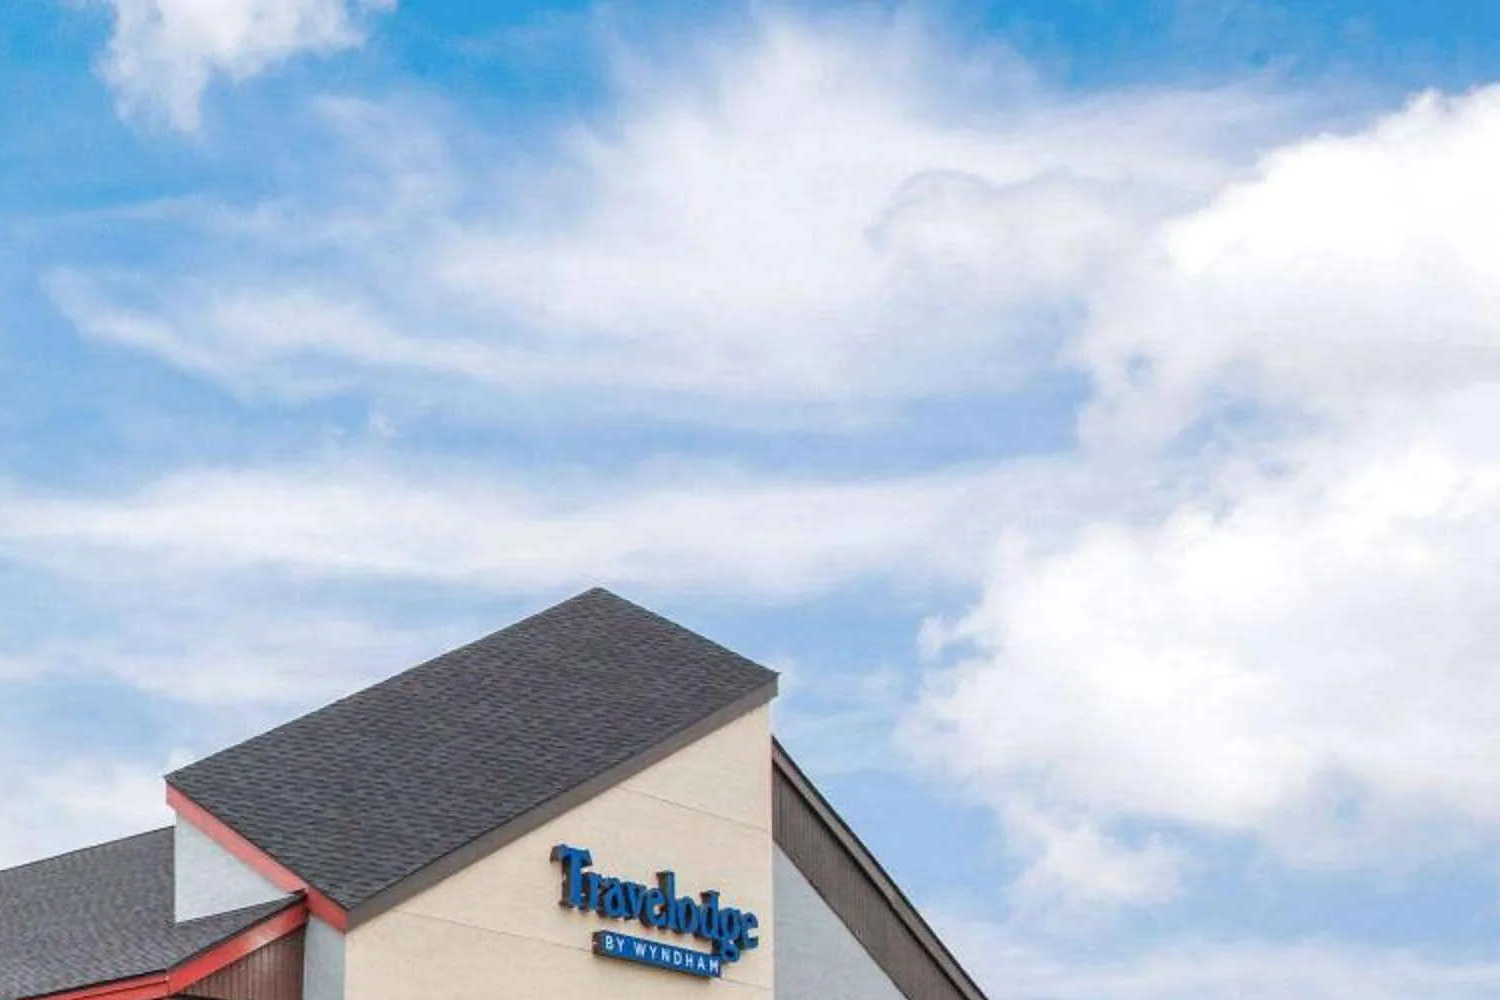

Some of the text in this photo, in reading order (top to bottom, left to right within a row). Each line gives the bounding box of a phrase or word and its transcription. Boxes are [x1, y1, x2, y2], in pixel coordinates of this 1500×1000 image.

[550, 843, 759, 963] Travelodge
[605, 935, 719, 974] BY WYNDHAM
